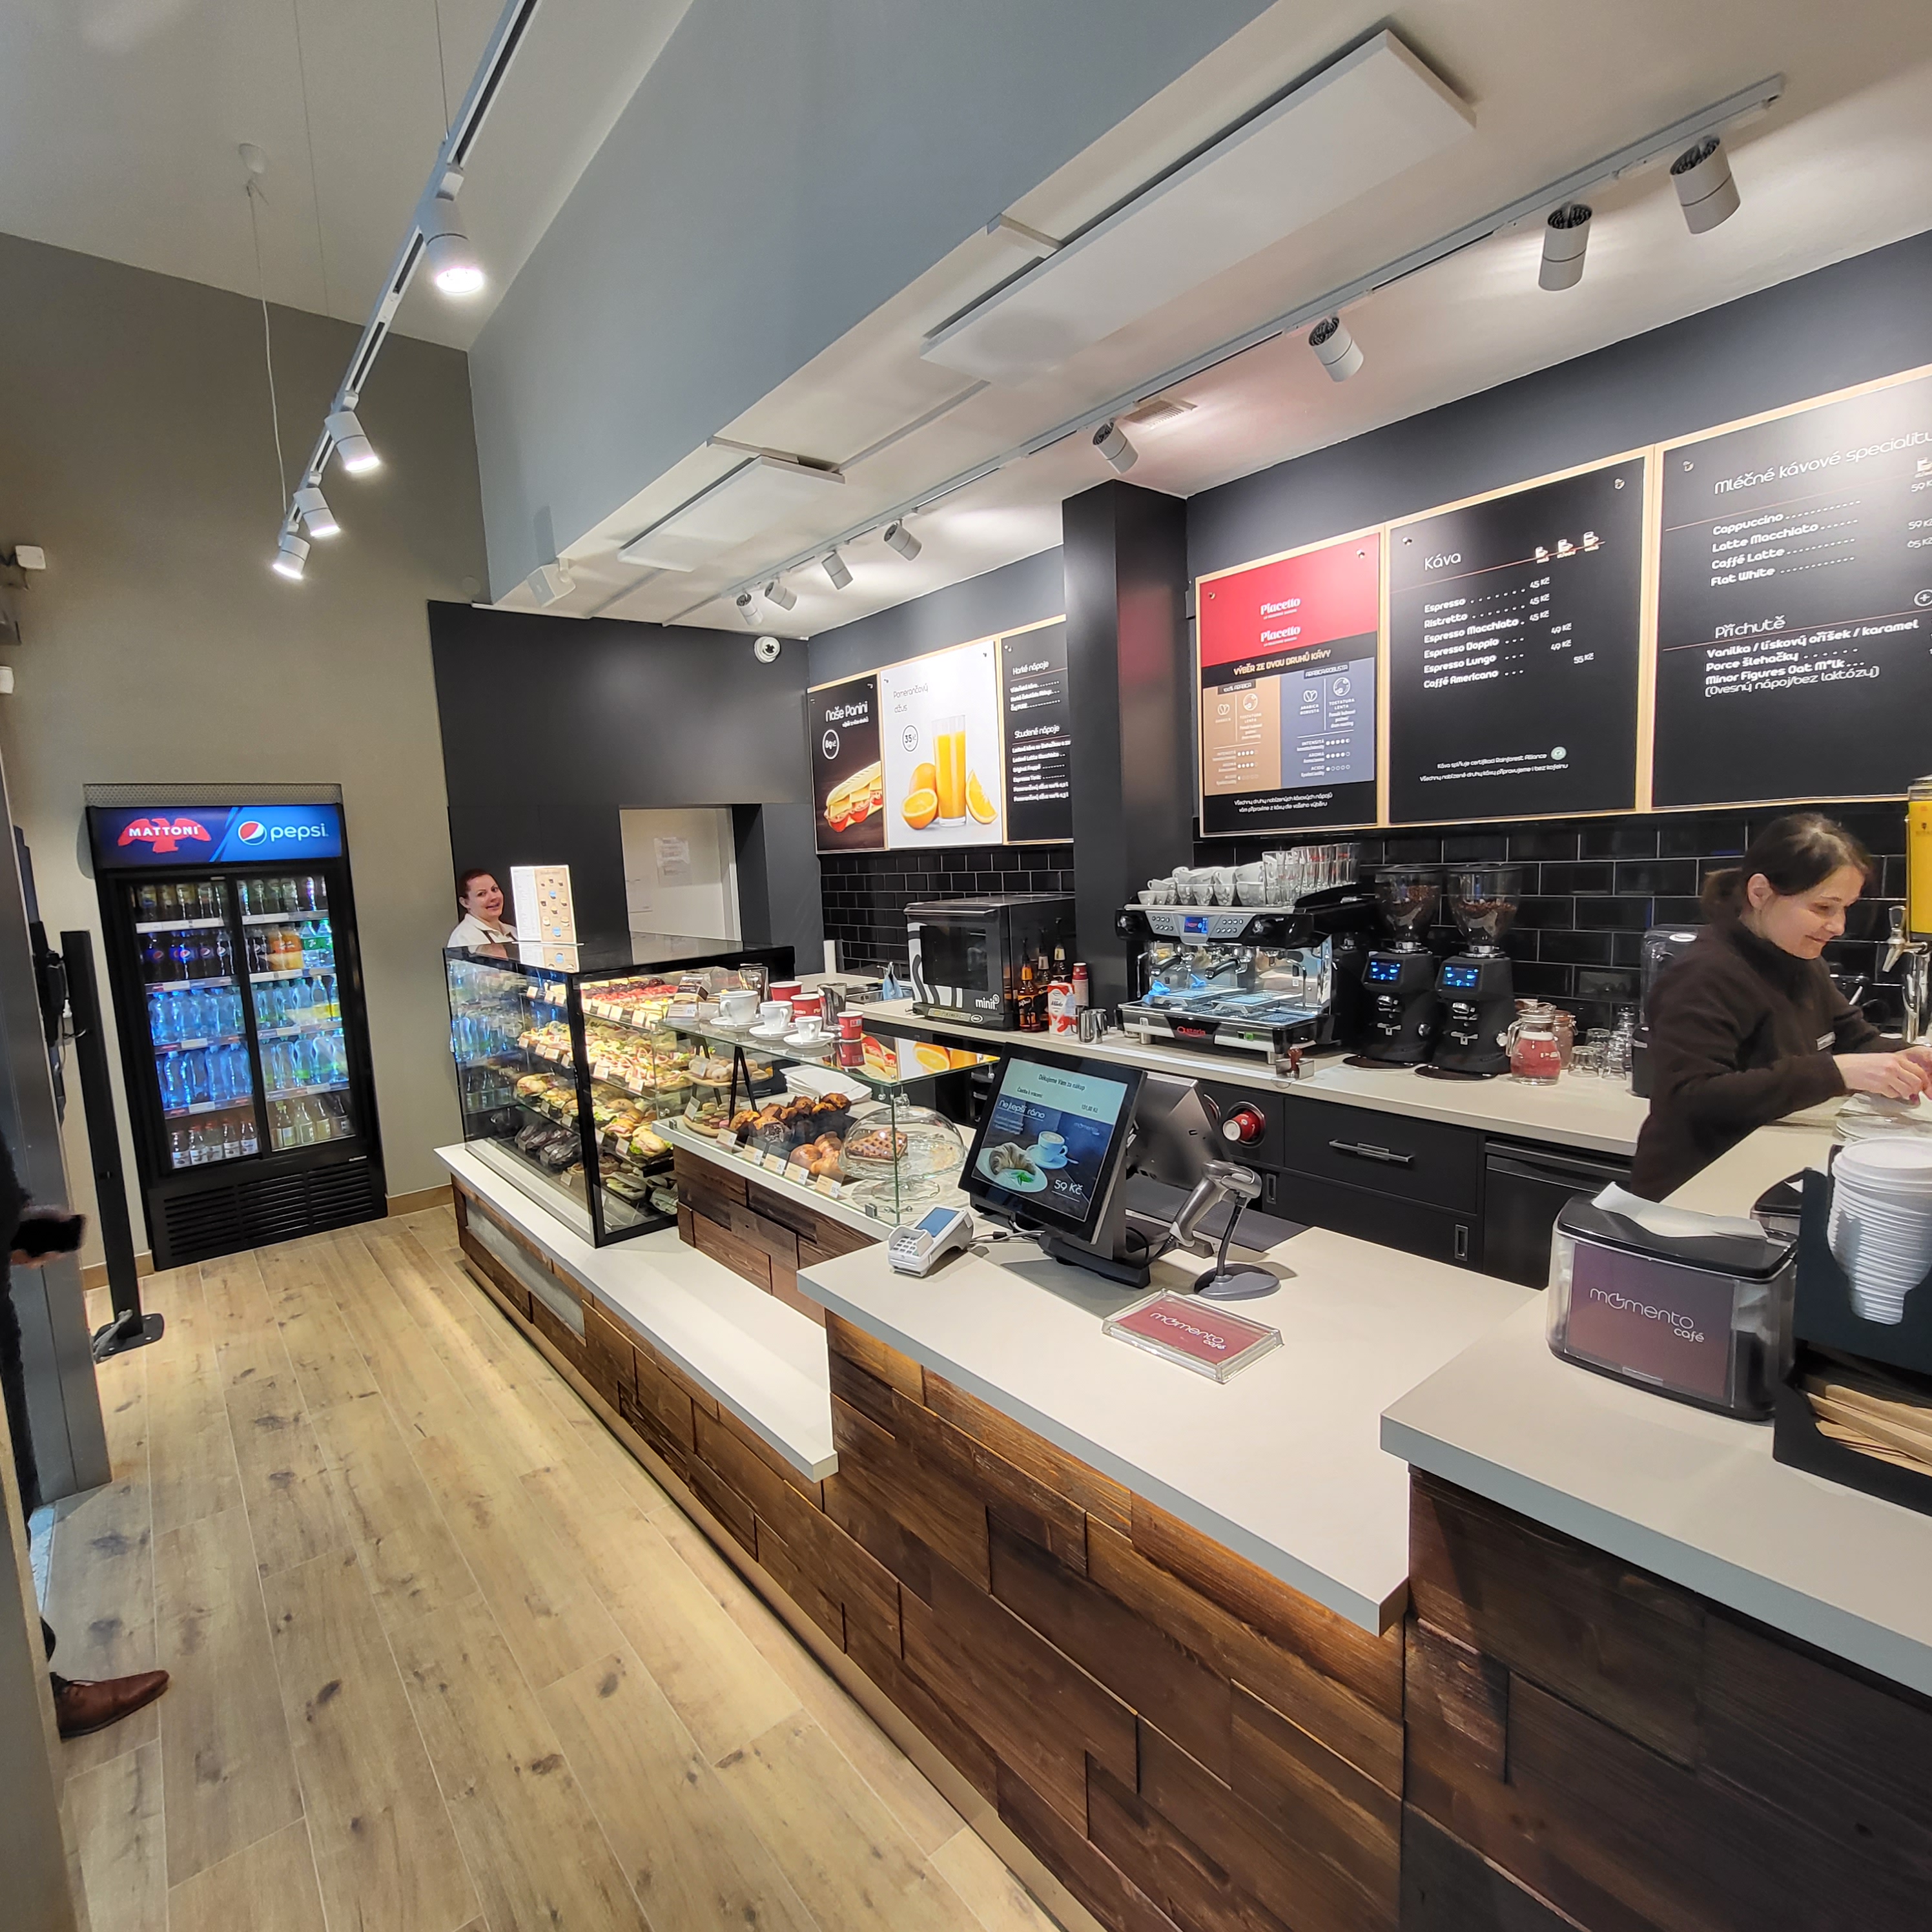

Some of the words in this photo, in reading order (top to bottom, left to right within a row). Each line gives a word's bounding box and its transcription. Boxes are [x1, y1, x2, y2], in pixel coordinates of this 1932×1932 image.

[1714, 468, 1774, 495] Mléčné
[1779, 451, 1841, 478] kávové
[1713, 513, 1783, 535] Cappuccino
[1911, 482, 1925, 492] 59
[1712, 538, 1748, 553] Latte
[1751, 524, 1818, 544] Macchiato
[1747, 548, 1785, 563] Latte
[1908, 520, 1922, 530] 59
[1424, 553, 1461, 571] Káva
[1711, 574, 1737, 587] Flat
[1739, 568, 1775, 581] White
[1907, 540, 1921, 548] 65
[1424, 598, 1466, 613] Espresso
[1530, 580, 1540, 588] 45
[1540, 577, 1550, 585] Kč
[1424, 613, 1468, 628] Ristretto
[1530, 597, 1540, 605] 45
[1540, 593, 1550, 602] Kč
[1424, 630, 1465, 643] Espresso
[1466, 618, 1519, 635] Macchiato
[1529, 613, 1539, 621] 45
[1715, 615, 1786, 639] Příchutě
[1424, 644, 1465, 659] Espresso
[1466, 638, 1500, 651] Doppio
[1551, 626, 1561, 634] 49
[1562, 622, 1572, 631] Kč
[1707, 646, 1751, 658] Vanilka
[1761, 635, 1807, 651] lískový
[1809, 630, 1851, 644] oříšek
[1862, 619, 1920, 636] karamel
[1028, 660, 1049, 672] nápoje
[1233, 663, 1255, 675] VÝBĚR
[1256, 663, 1266, 672] ZE
[1266, 659, 1285, 669] DVOU
[1286, 652, 1310, 664] DRUHŮ
[1311, 649, 1331, 661] KÁVY
[1424, 660, 1464, 673] Espresso
[1466, 654, 1497, 666] Lungo
[1550, 642, 1561, 651] 49
[1562, 639, 1572, 648] Kč
[1706, 661, 1740, 672] Porce
[1742, 651, 1799, 666] šlehačky
[1450, 670, 1499, 684] Americano
[1574, 655, 1585, 664] 55
[1585, 652, 1594, 661] Kč
[1705, 674, 1740, 684] Minor
[1741, 668, 1786, 681] Figures
[1788, 663, 1813, 674] Oat
[893, 683, 929, 699] Pomerančový
[1705, 682, 1752, 697] (Ovesný
[825, 706, 845, 722] Naše
[845, 701, 868, 717] Panini
[894, 704, 907, 713] džus
[905, 734, 912, 743] 35
[1039, 724, 1060, 735] nápoje
[129, 826, 198, 837] MATTONI
[271, 823, 326, 842] pepsi
[1027, 1108, 1045, 1118] ráno
[1054, 1179, 1068, 1191] 59
[1069, 1183, 1084, 1195] Kč
[1590, 1288, 1694, 1329] momento
[1150, 1312, 1224, 1344] momento
[1674, 1328, 1705, 1342] café
[1203, 1339, 1226, 1350] café
